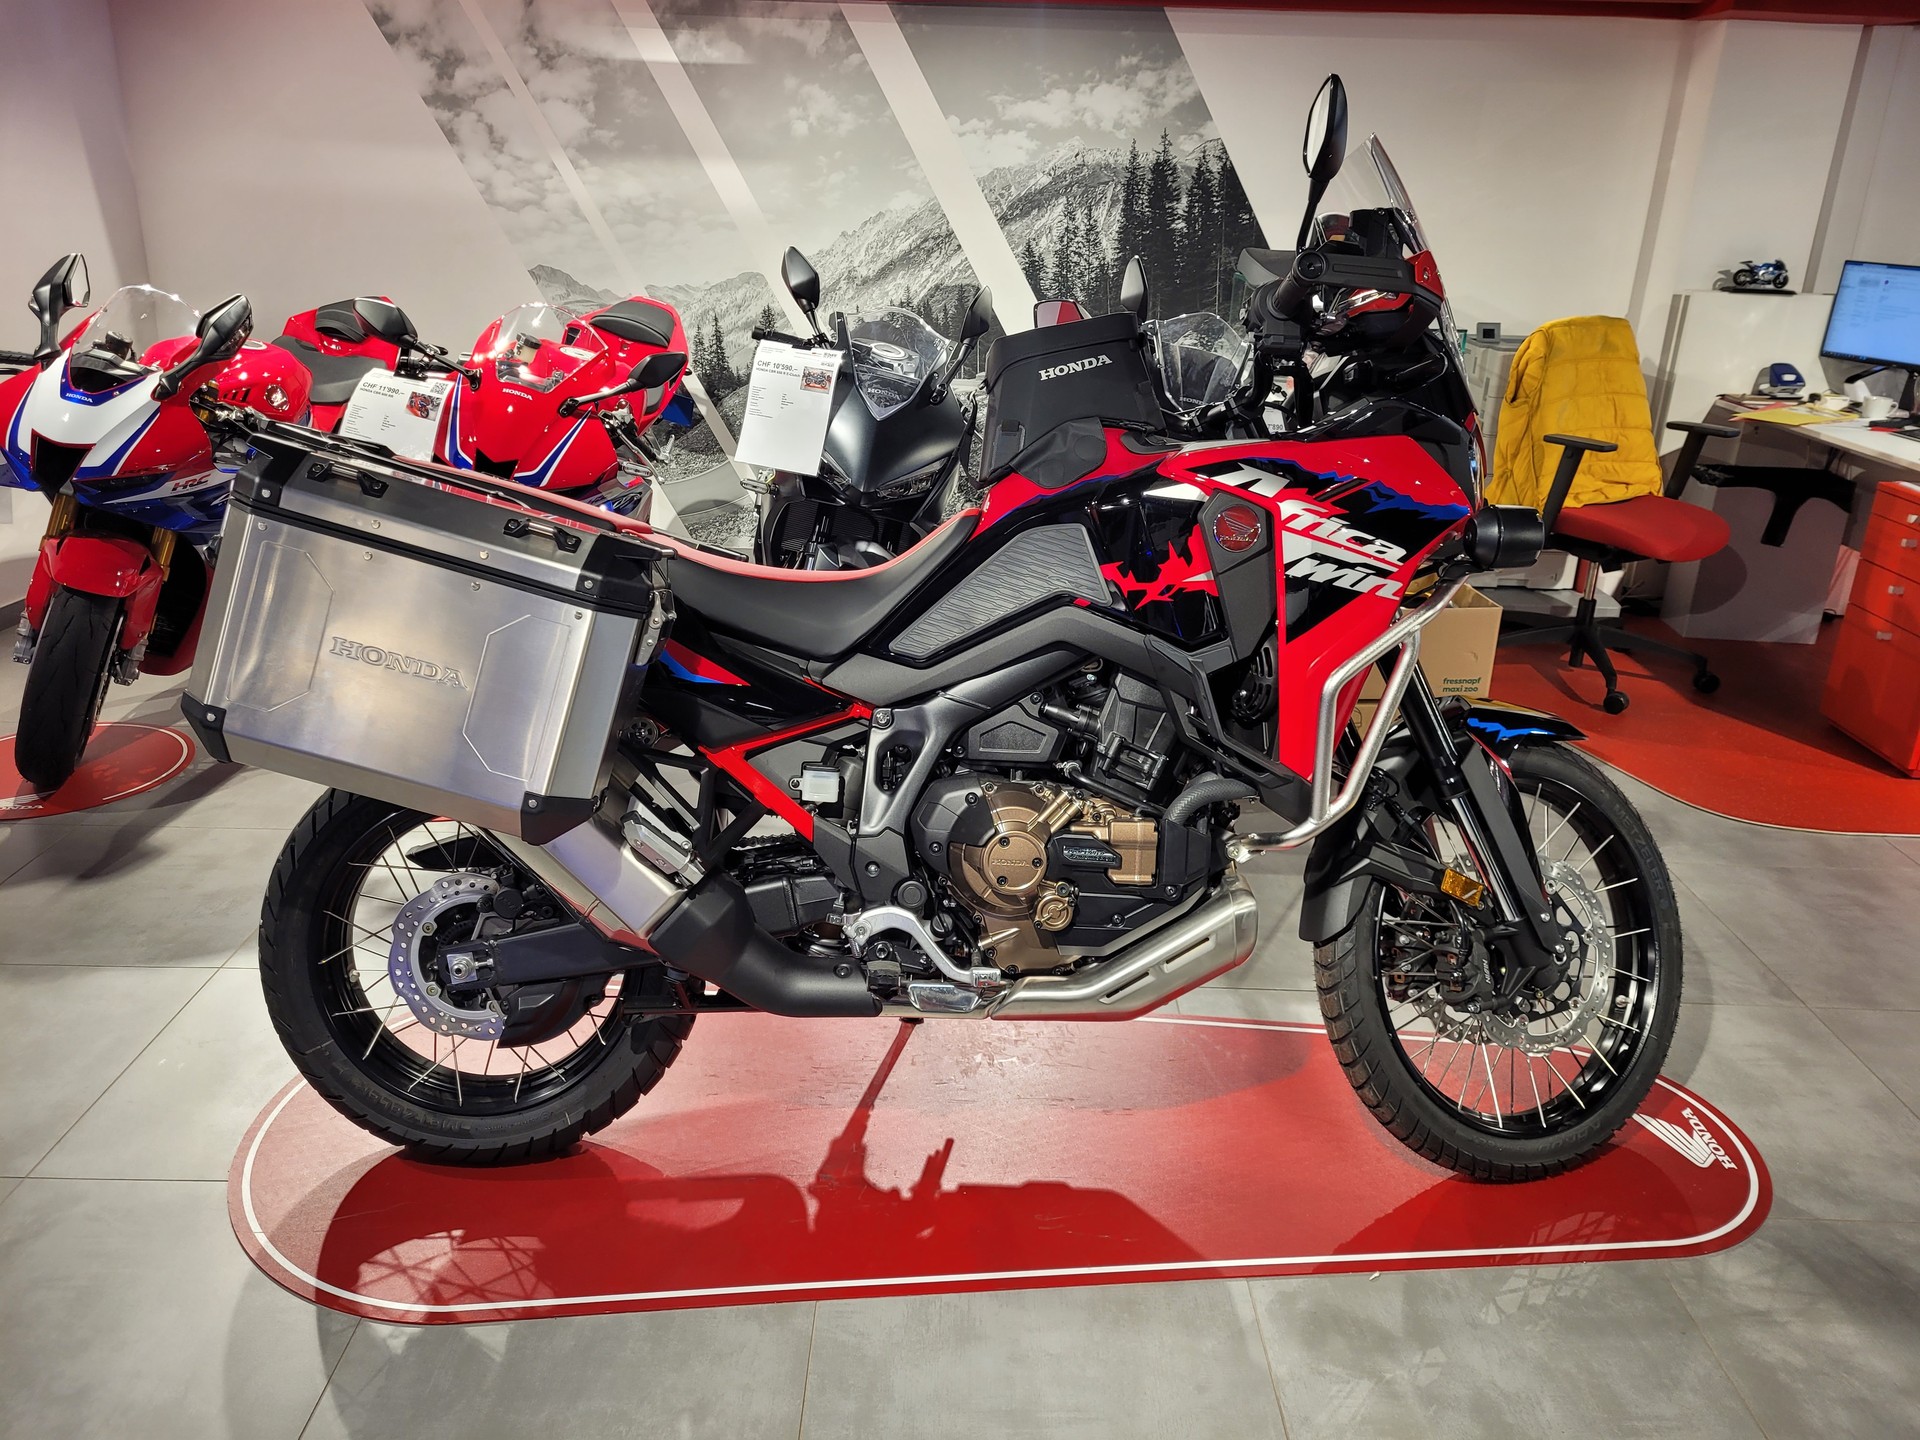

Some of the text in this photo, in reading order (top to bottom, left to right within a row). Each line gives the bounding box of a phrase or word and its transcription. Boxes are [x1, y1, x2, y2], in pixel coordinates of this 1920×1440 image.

[757, 360, 771, 368] CHF
[1038, 354, 1113, 381] HONDA
[362, 381, 378, 389] CHF
[65, 392, 93, 403] HONDA
[502, 387, 533, 401] HONDA
[867, 387, 901, 401] HONDA
[171, 473, 212, 492] HRC
[328, 636, 470, 691] HONDA
[1443, 676, 1482, 686] fressnapf
[1442, 685, 1463, 693] maxi
[1614, 803, 1665, 892] METZELER
[991, 858, 1031, 868] HONDA
[1681, 1106, 1738, 1170] HONDA
